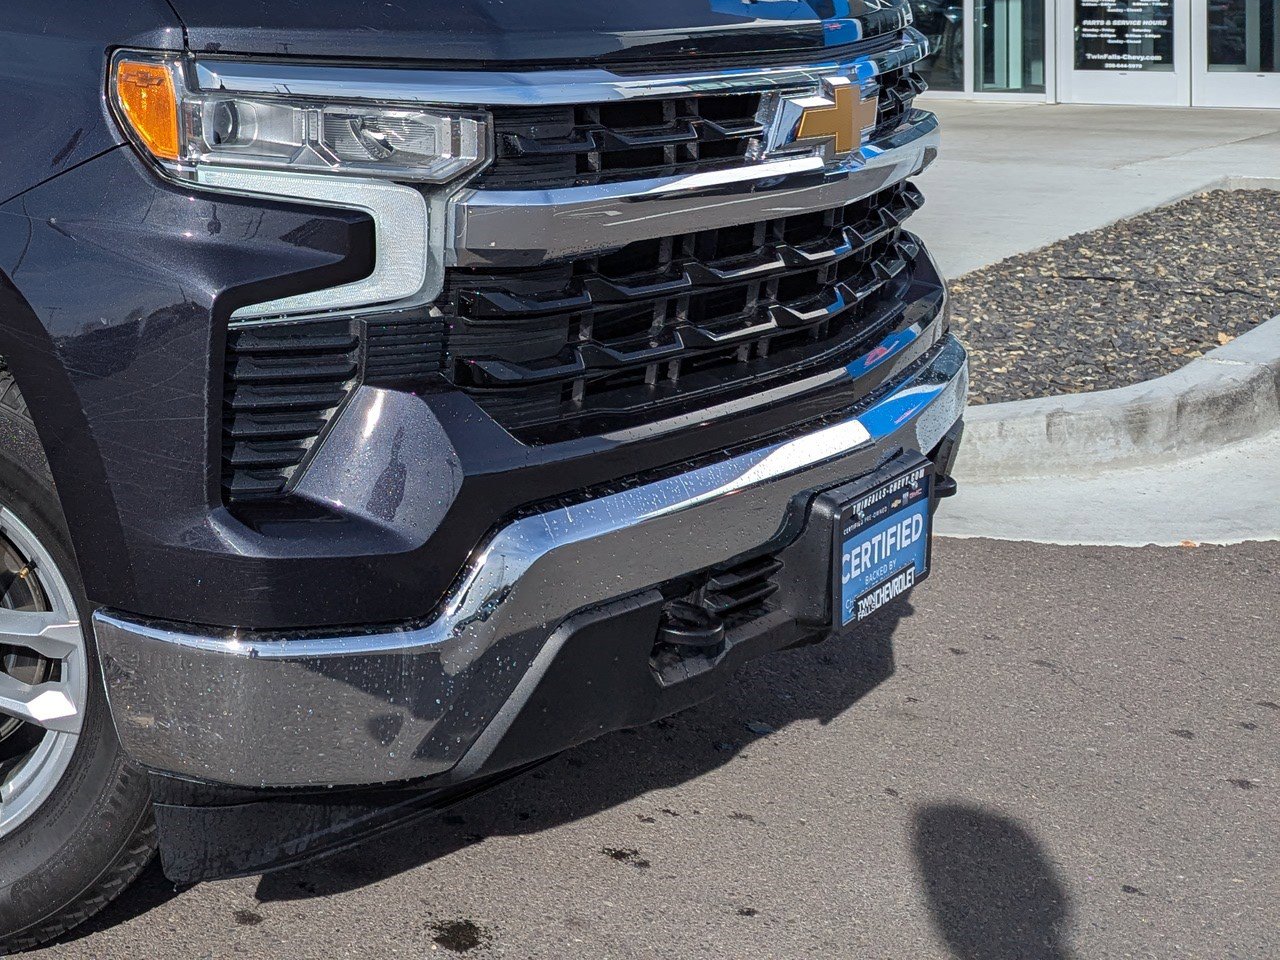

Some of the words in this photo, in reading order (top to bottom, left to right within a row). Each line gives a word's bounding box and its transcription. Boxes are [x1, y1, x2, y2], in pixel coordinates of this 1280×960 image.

[842, 513, 924, 585] CERTIFIED
[864, 564, 888, 585] BACKED
[889, 558, 897, 570] BY
[874, 566, 916, 609] CHEVROLET
[857, 593, 876, 612] TWIN
[857, 603, 876, 622] FALLS
